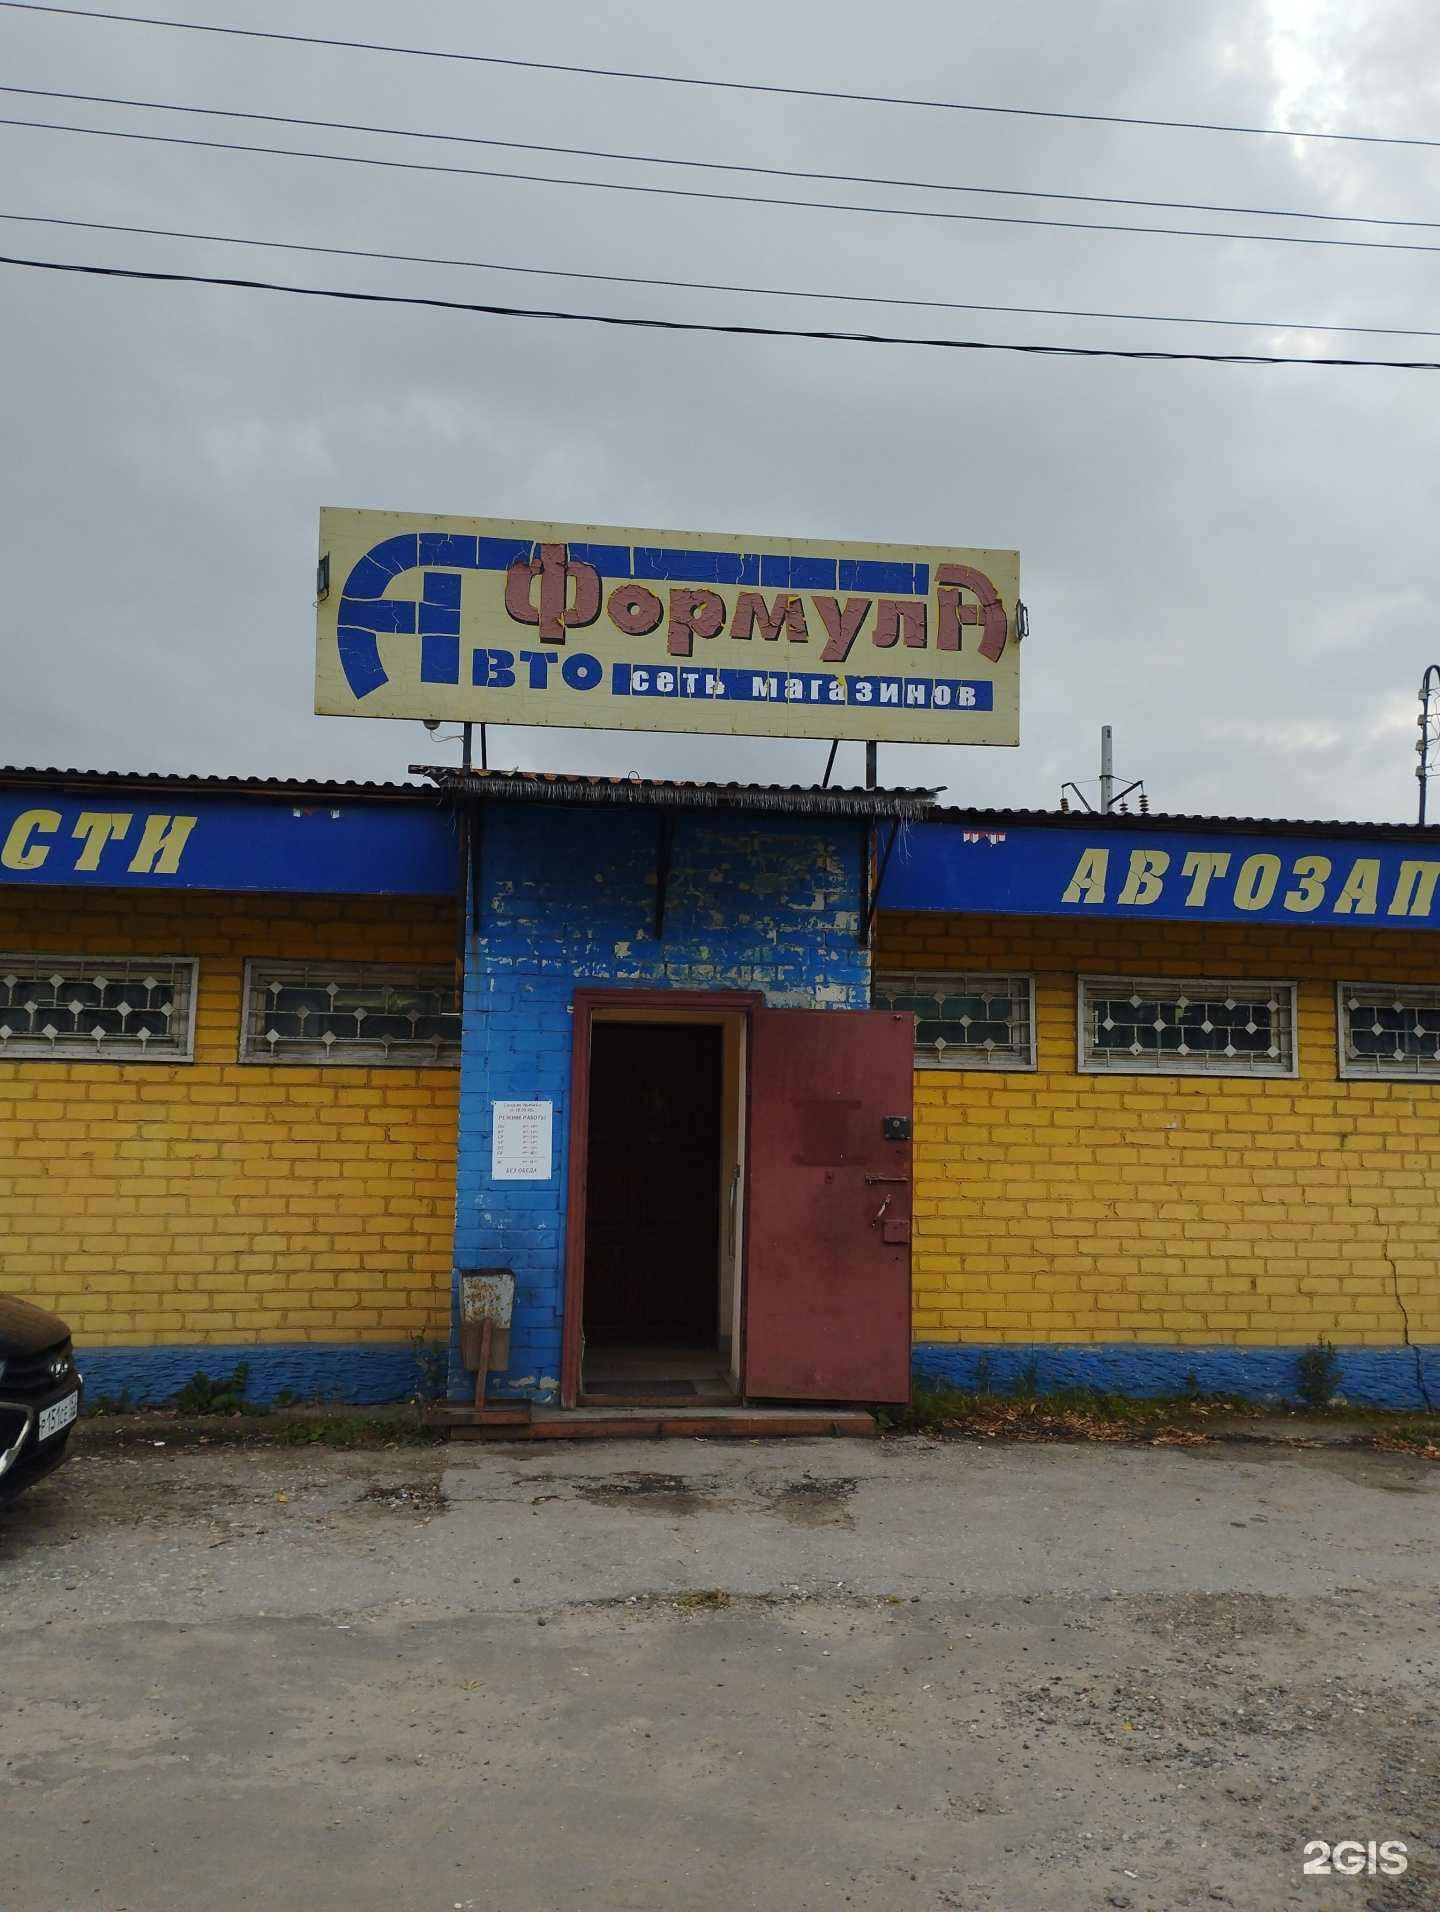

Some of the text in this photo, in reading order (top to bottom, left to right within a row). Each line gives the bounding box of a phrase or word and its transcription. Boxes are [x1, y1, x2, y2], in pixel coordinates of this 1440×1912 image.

[632, 670, 977, 707] сеть магазинов
[1, 809, 199, 875] СТИ
[1060, 847, 1440, 917] АВТОЗАП
